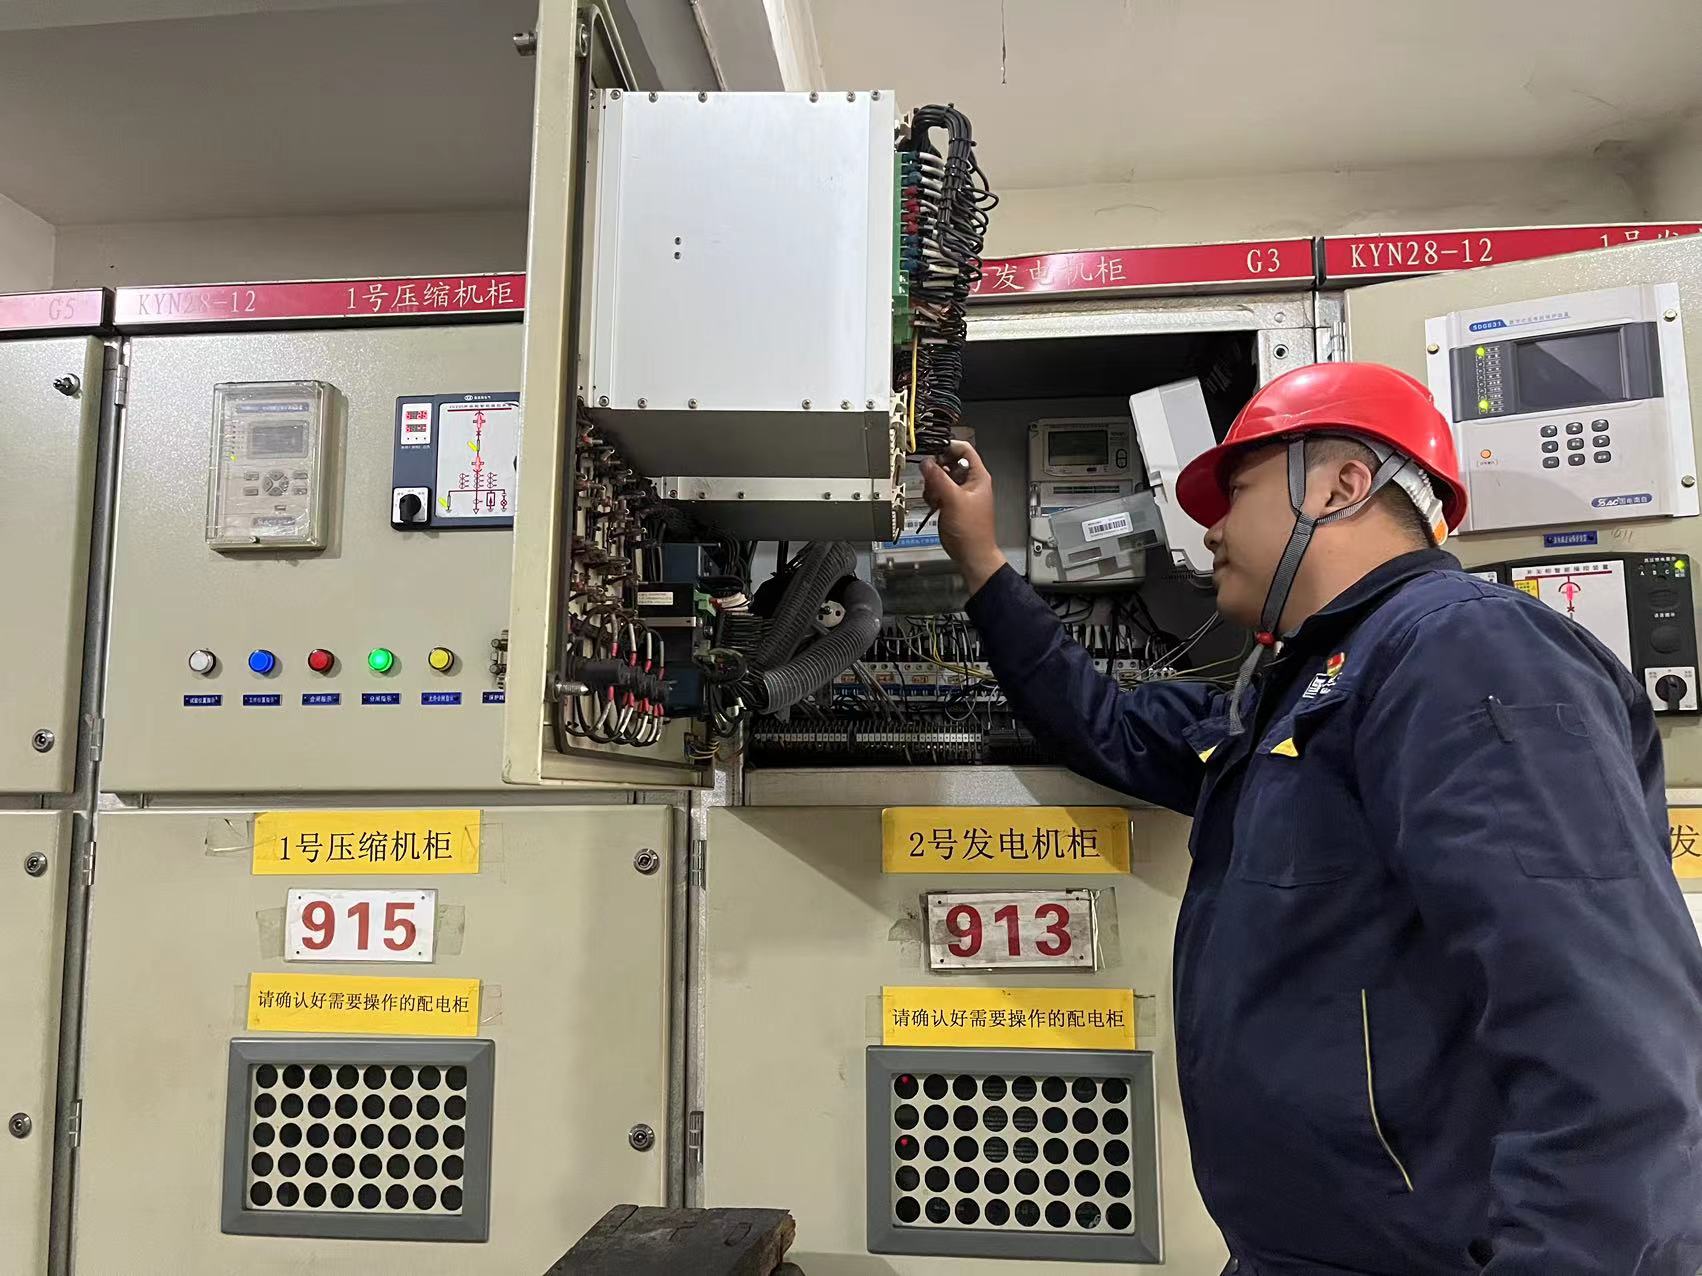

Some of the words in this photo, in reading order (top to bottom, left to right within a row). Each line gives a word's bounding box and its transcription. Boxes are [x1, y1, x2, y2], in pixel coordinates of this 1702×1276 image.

[1246, 248, 1281, 274] G3
[1350, 237, 1494, 268] KYN28-12
[48, 298, 75, 320] G5
[138, 290, 256, 316] KYN28-12
[346, 279, 514, 312] 1号压缩机柜
[279, 829, 453, 863] 1号压缩机柜
[908, 826, 1101, 861] 2号发电机柜
[301, 900, 417, 951] 915
[945, 903, 1073, 957] 913
[257, 989, 470, 1014] 请确认好需要操作的配电柜
[892, 1008, 1126, 1028] 请确认好需要操作的配电柜
